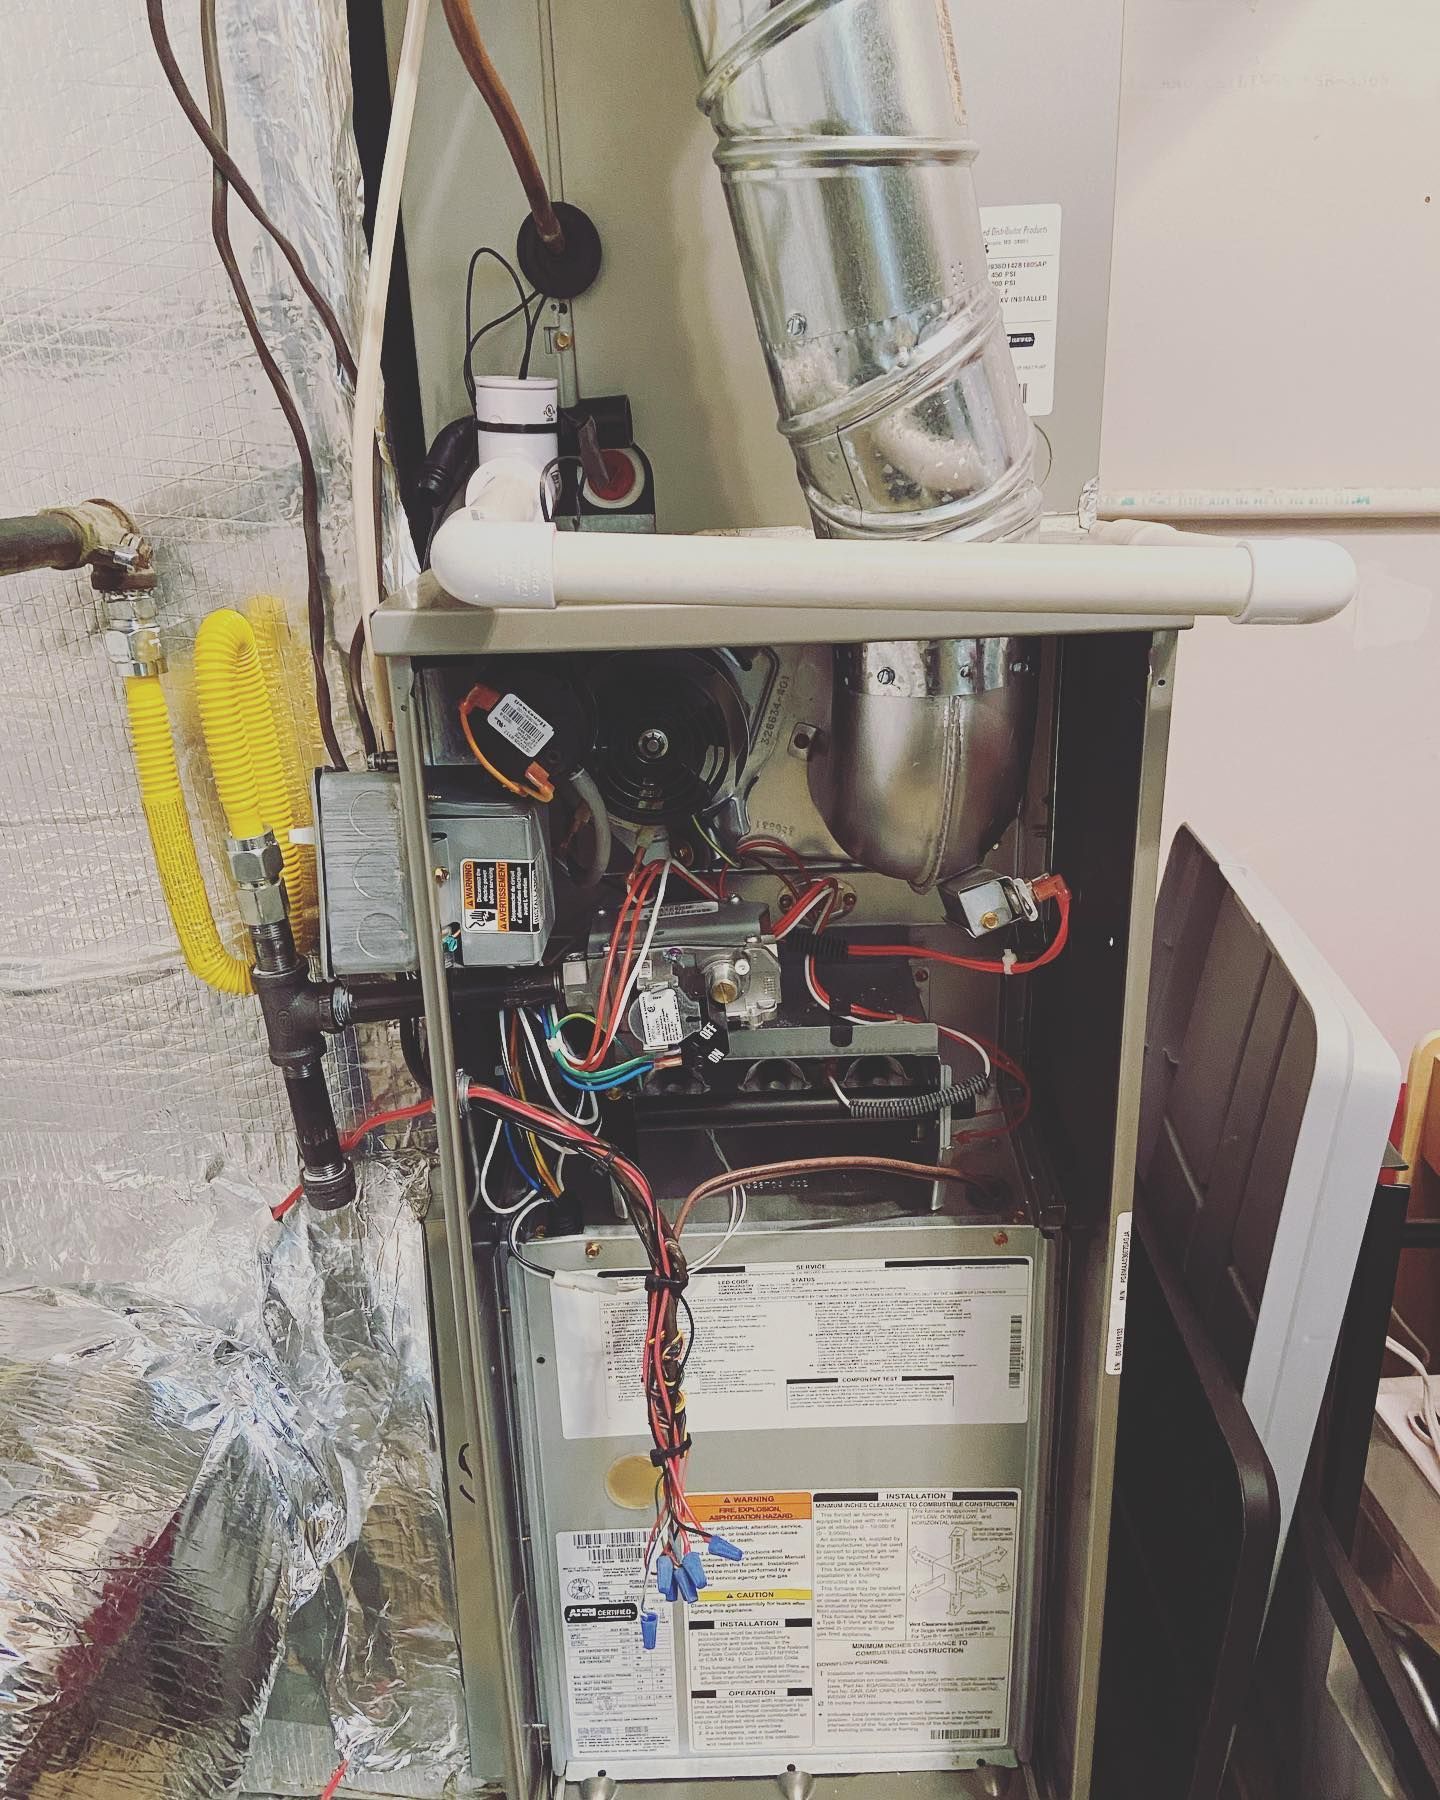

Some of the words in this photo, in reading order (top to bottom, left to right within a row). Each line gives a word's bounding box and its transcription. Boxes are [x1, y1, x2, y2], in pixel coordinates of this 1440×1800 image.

[1024, 226, 1047, 234] Products
[498, 864, 507, 922] AVERTISSEMENT
[700, 1022, 718, 1041] OFF
[708, 1048, 724, 1064] ON
